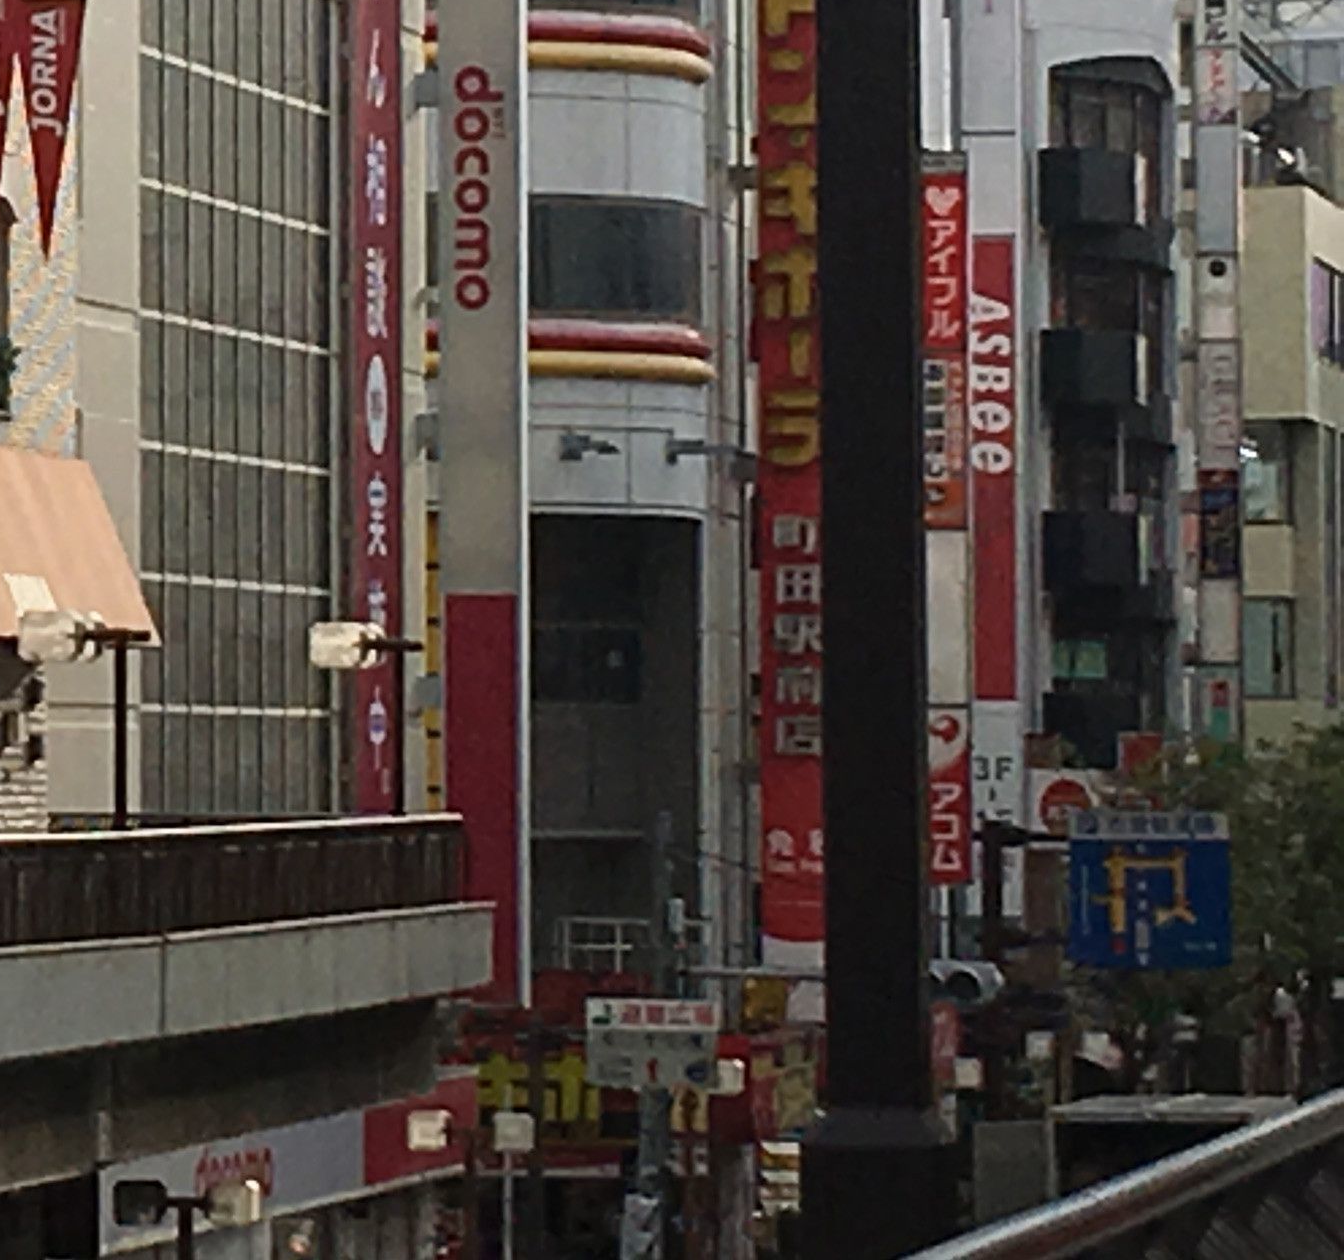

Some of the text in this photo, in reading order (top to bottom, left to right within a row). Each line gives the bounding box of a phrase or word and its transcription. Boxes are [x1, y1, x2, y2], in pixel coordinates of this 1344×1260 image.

[30, 8, 64, 137] JORNA
[452, 64, 505, 311] docomo
[927, 220, 962, 339] アイフル
[970, 291, 1013, 475] ASBee
[930, 782, 962, 872] アコム
[972, 755, 1014, 782] 3F
